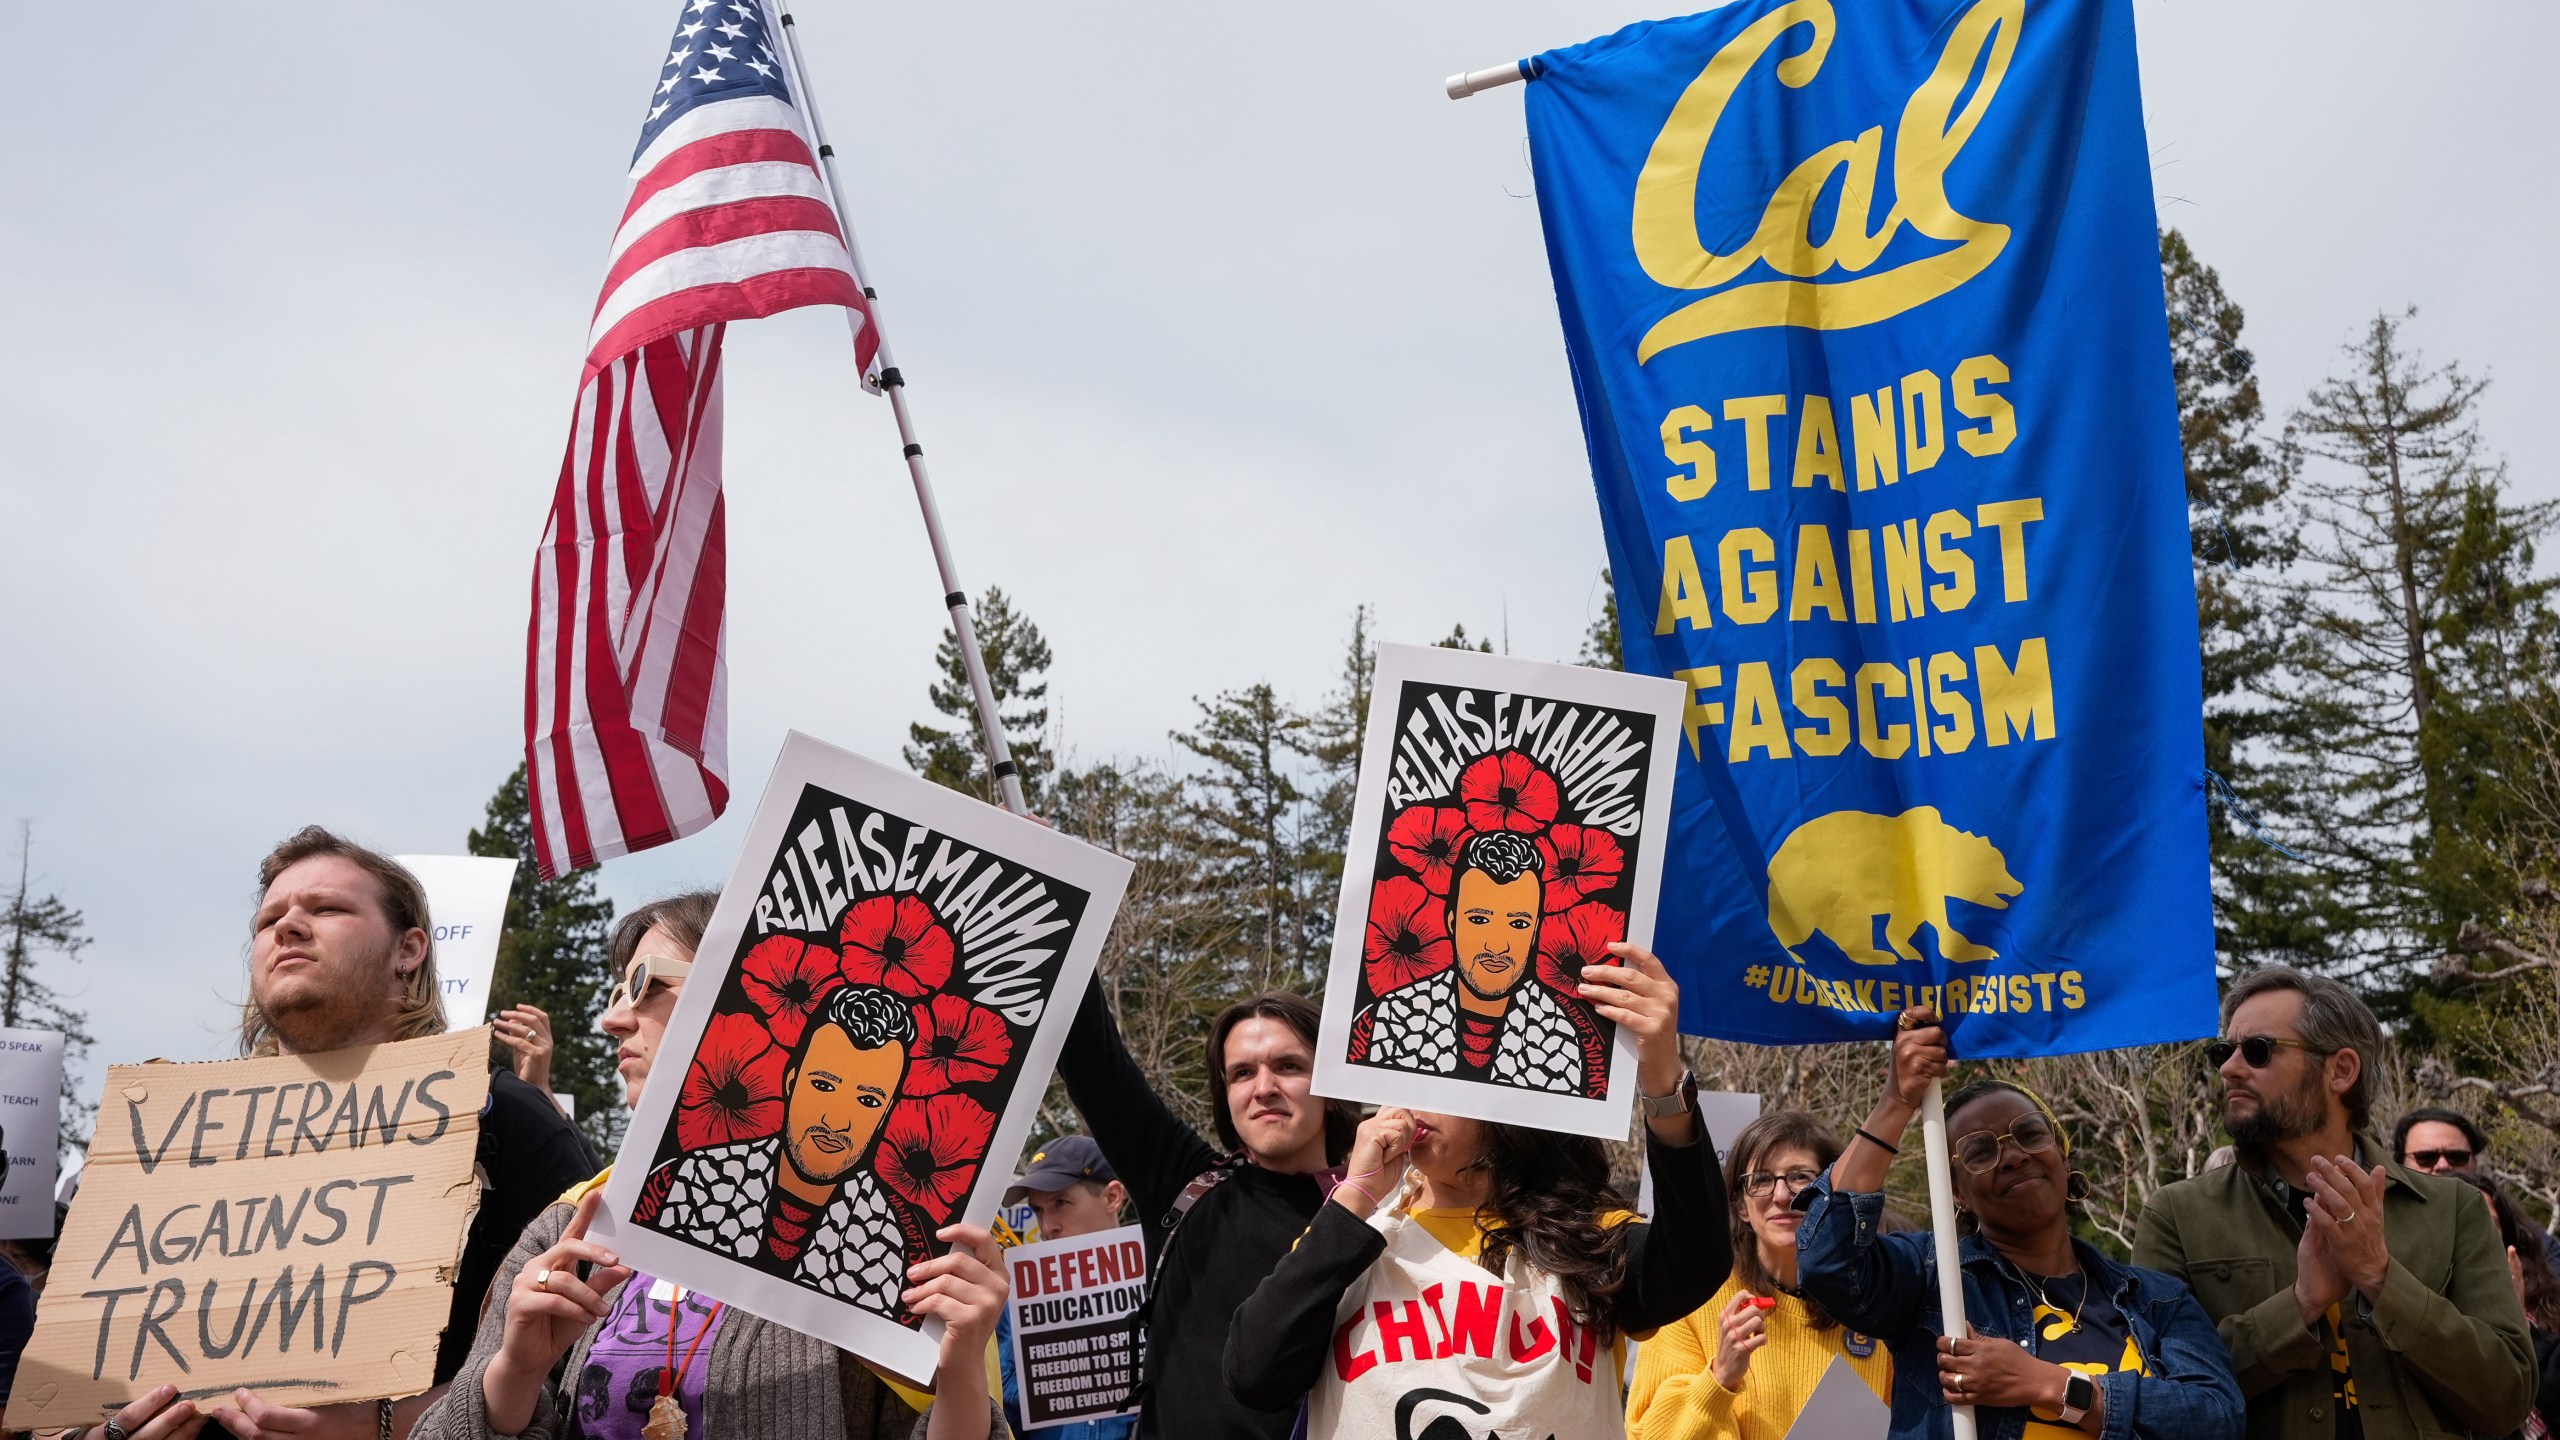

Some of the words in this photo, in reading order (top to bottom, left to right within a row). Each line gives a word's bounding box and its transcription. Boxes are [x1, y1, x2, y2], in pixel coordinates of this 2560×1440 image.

[1632, 0, 2025, 366] Cal
[1659, 354, 2018, 502] STANDS
[1654, 498, 2044, 636] AGAINST
[1673, 637, 2057, 763] FASCISM
[1387, 690, 1511, 810] RELEASE
[1513, 698, 1647, 836] MAHMOUD
[434, 925, 473, 941] OFF
[755, 807, 930, 934] RELEASE
[916, 839, 1071, 1026] MAHMOUD
[9, 1041, 43, 1053] SPEAK
[1581, 1035, 1608, 1098] STUDENTS
[3, 1095, 39, 1107] TEACH
[127, 1070, 455, 1174] VETERANS
[91, 1175, 414, 1280] AGAINST
[1008, 1207, 1032, 1229] UP
[1013, 1240, 1145, 1299] DEFEND
[81, 1260, 397, 1381] TRUMP
[1029, 1338, 1090, 1360] FREEDOM
[1090, 1335, 1108, 1351] TO
[1031, 1356, 1092, 1378] FREEDOM
[1092, 1354, 1110, 1369] TO
[1033, 1375, 1093, 1396] FREEDOM
[1094, 1372, 1112, 1388] TO
[1049, 1395, 1074, 1412] FOR
[1076, 1387, 1130, 1410] EVERYO
